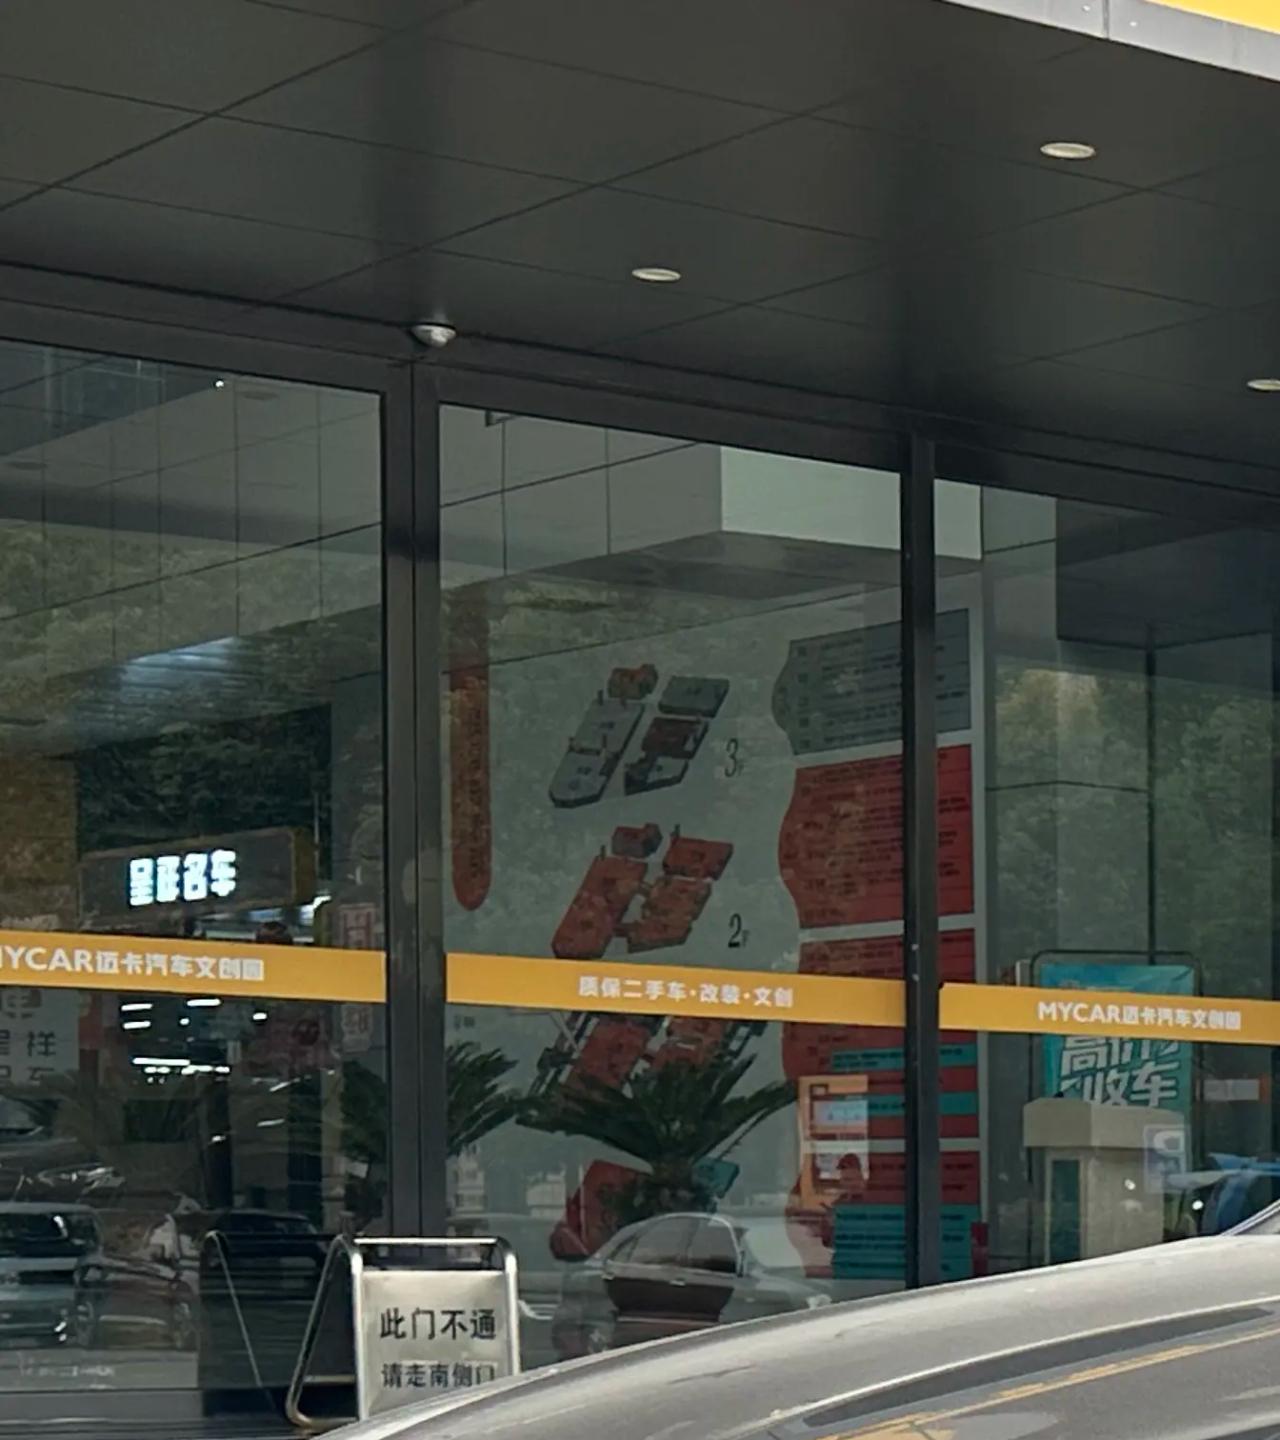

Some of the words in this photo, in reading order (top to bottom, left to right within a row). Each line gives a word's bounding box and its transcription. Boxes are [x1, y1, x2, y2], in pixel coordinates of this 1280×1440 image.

[380, 1307, 496, 1340] 此门不通
[381, 1361, 496, 1388] 请走南侧门
